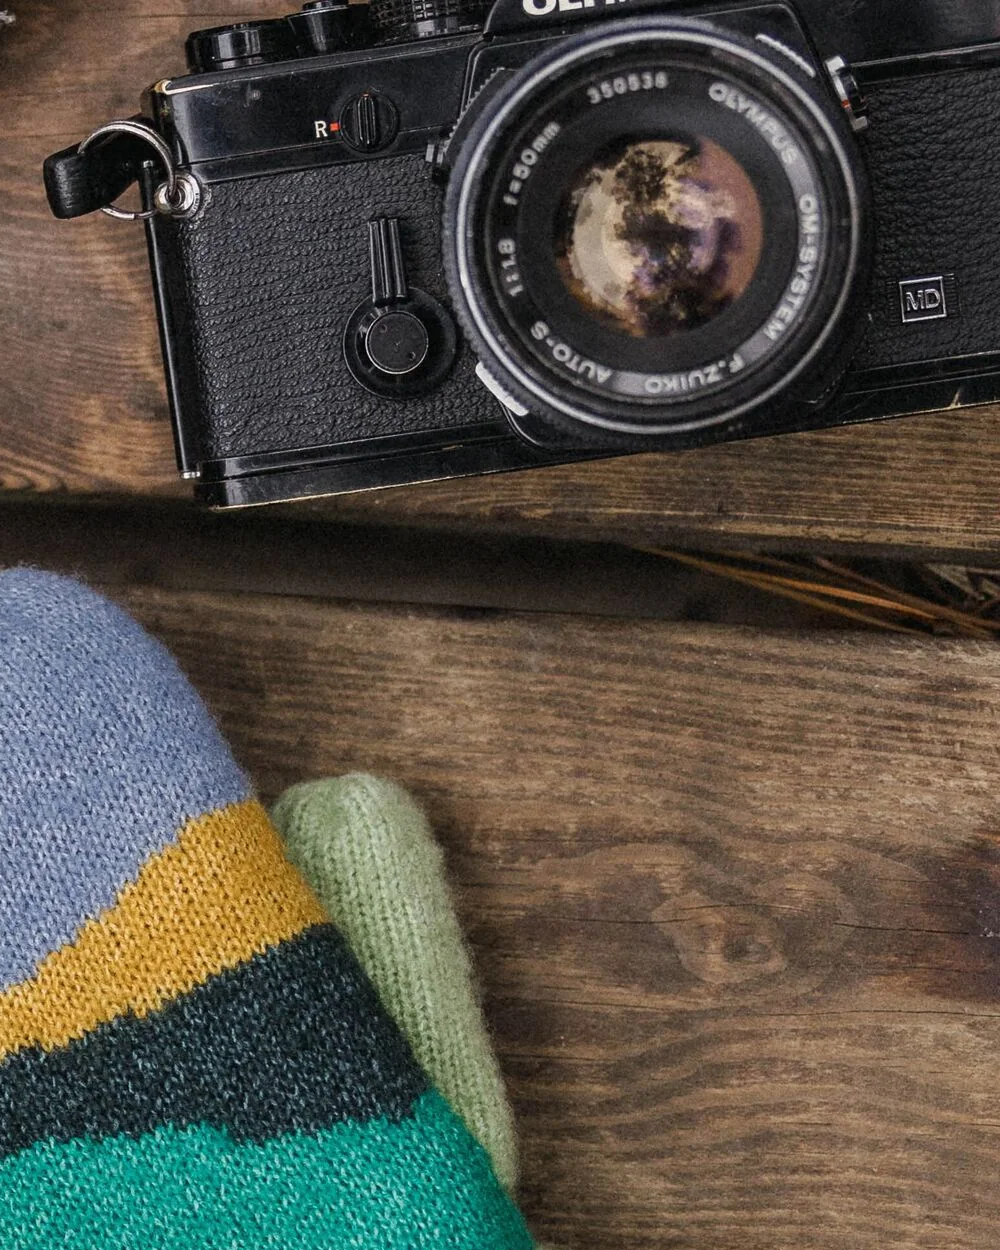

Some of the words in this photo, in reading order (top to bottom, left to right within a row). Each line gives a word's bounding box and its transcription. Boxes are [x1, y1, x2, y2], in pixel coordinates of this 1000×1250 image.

[314, 120, 328, 138] R
[708, 82, 798, 164] OLYMPUS
[763, 193, 820, 341] OM-SYSTEM
[906, 288, 941, 311] MD
[530, 320, 613, 383] AUTO-S
